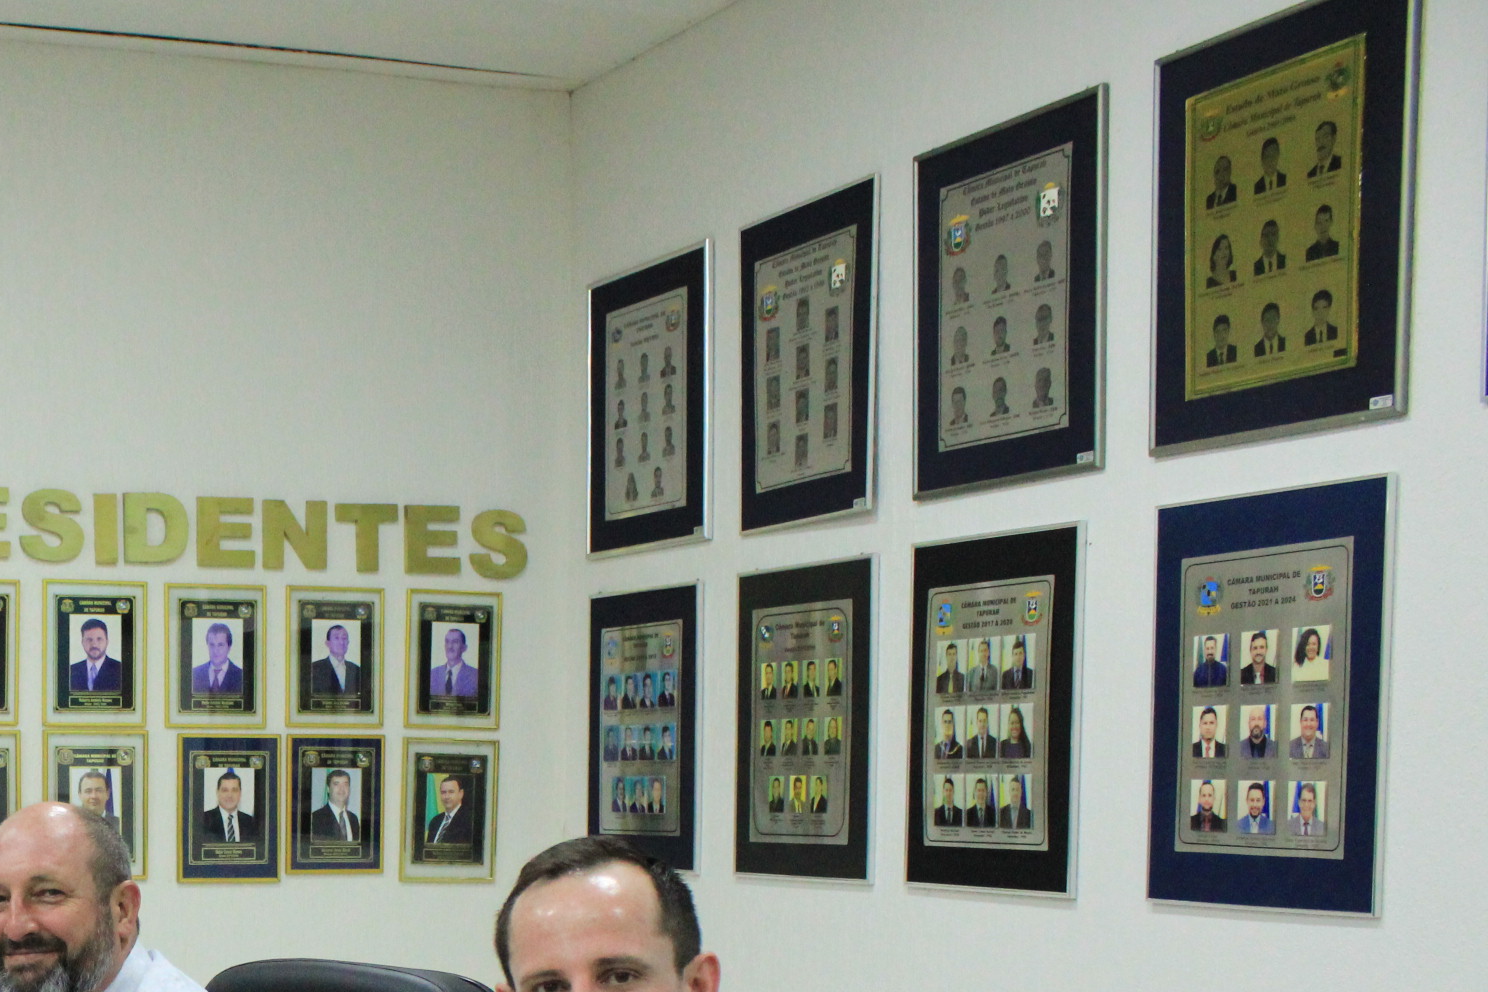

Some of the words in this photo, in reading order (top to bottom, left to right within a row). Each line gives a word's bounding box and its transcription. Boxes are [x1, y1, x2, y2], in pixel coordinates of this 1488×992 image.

[1227, 575, 1254, 586] CÂMARA
[1255, 572, 1289, 583] MUNICIPAL
[1292, 570, 1301, 579] DE
[1248, 586, 1279, 595] TAPURAH
[1230, 600, 1256, 610] GESTÃO
[1257, 598, 1273, 607] 2021
[1274, 597, 1280, 605] A
[1280, 595, 1297, 605] 2024
